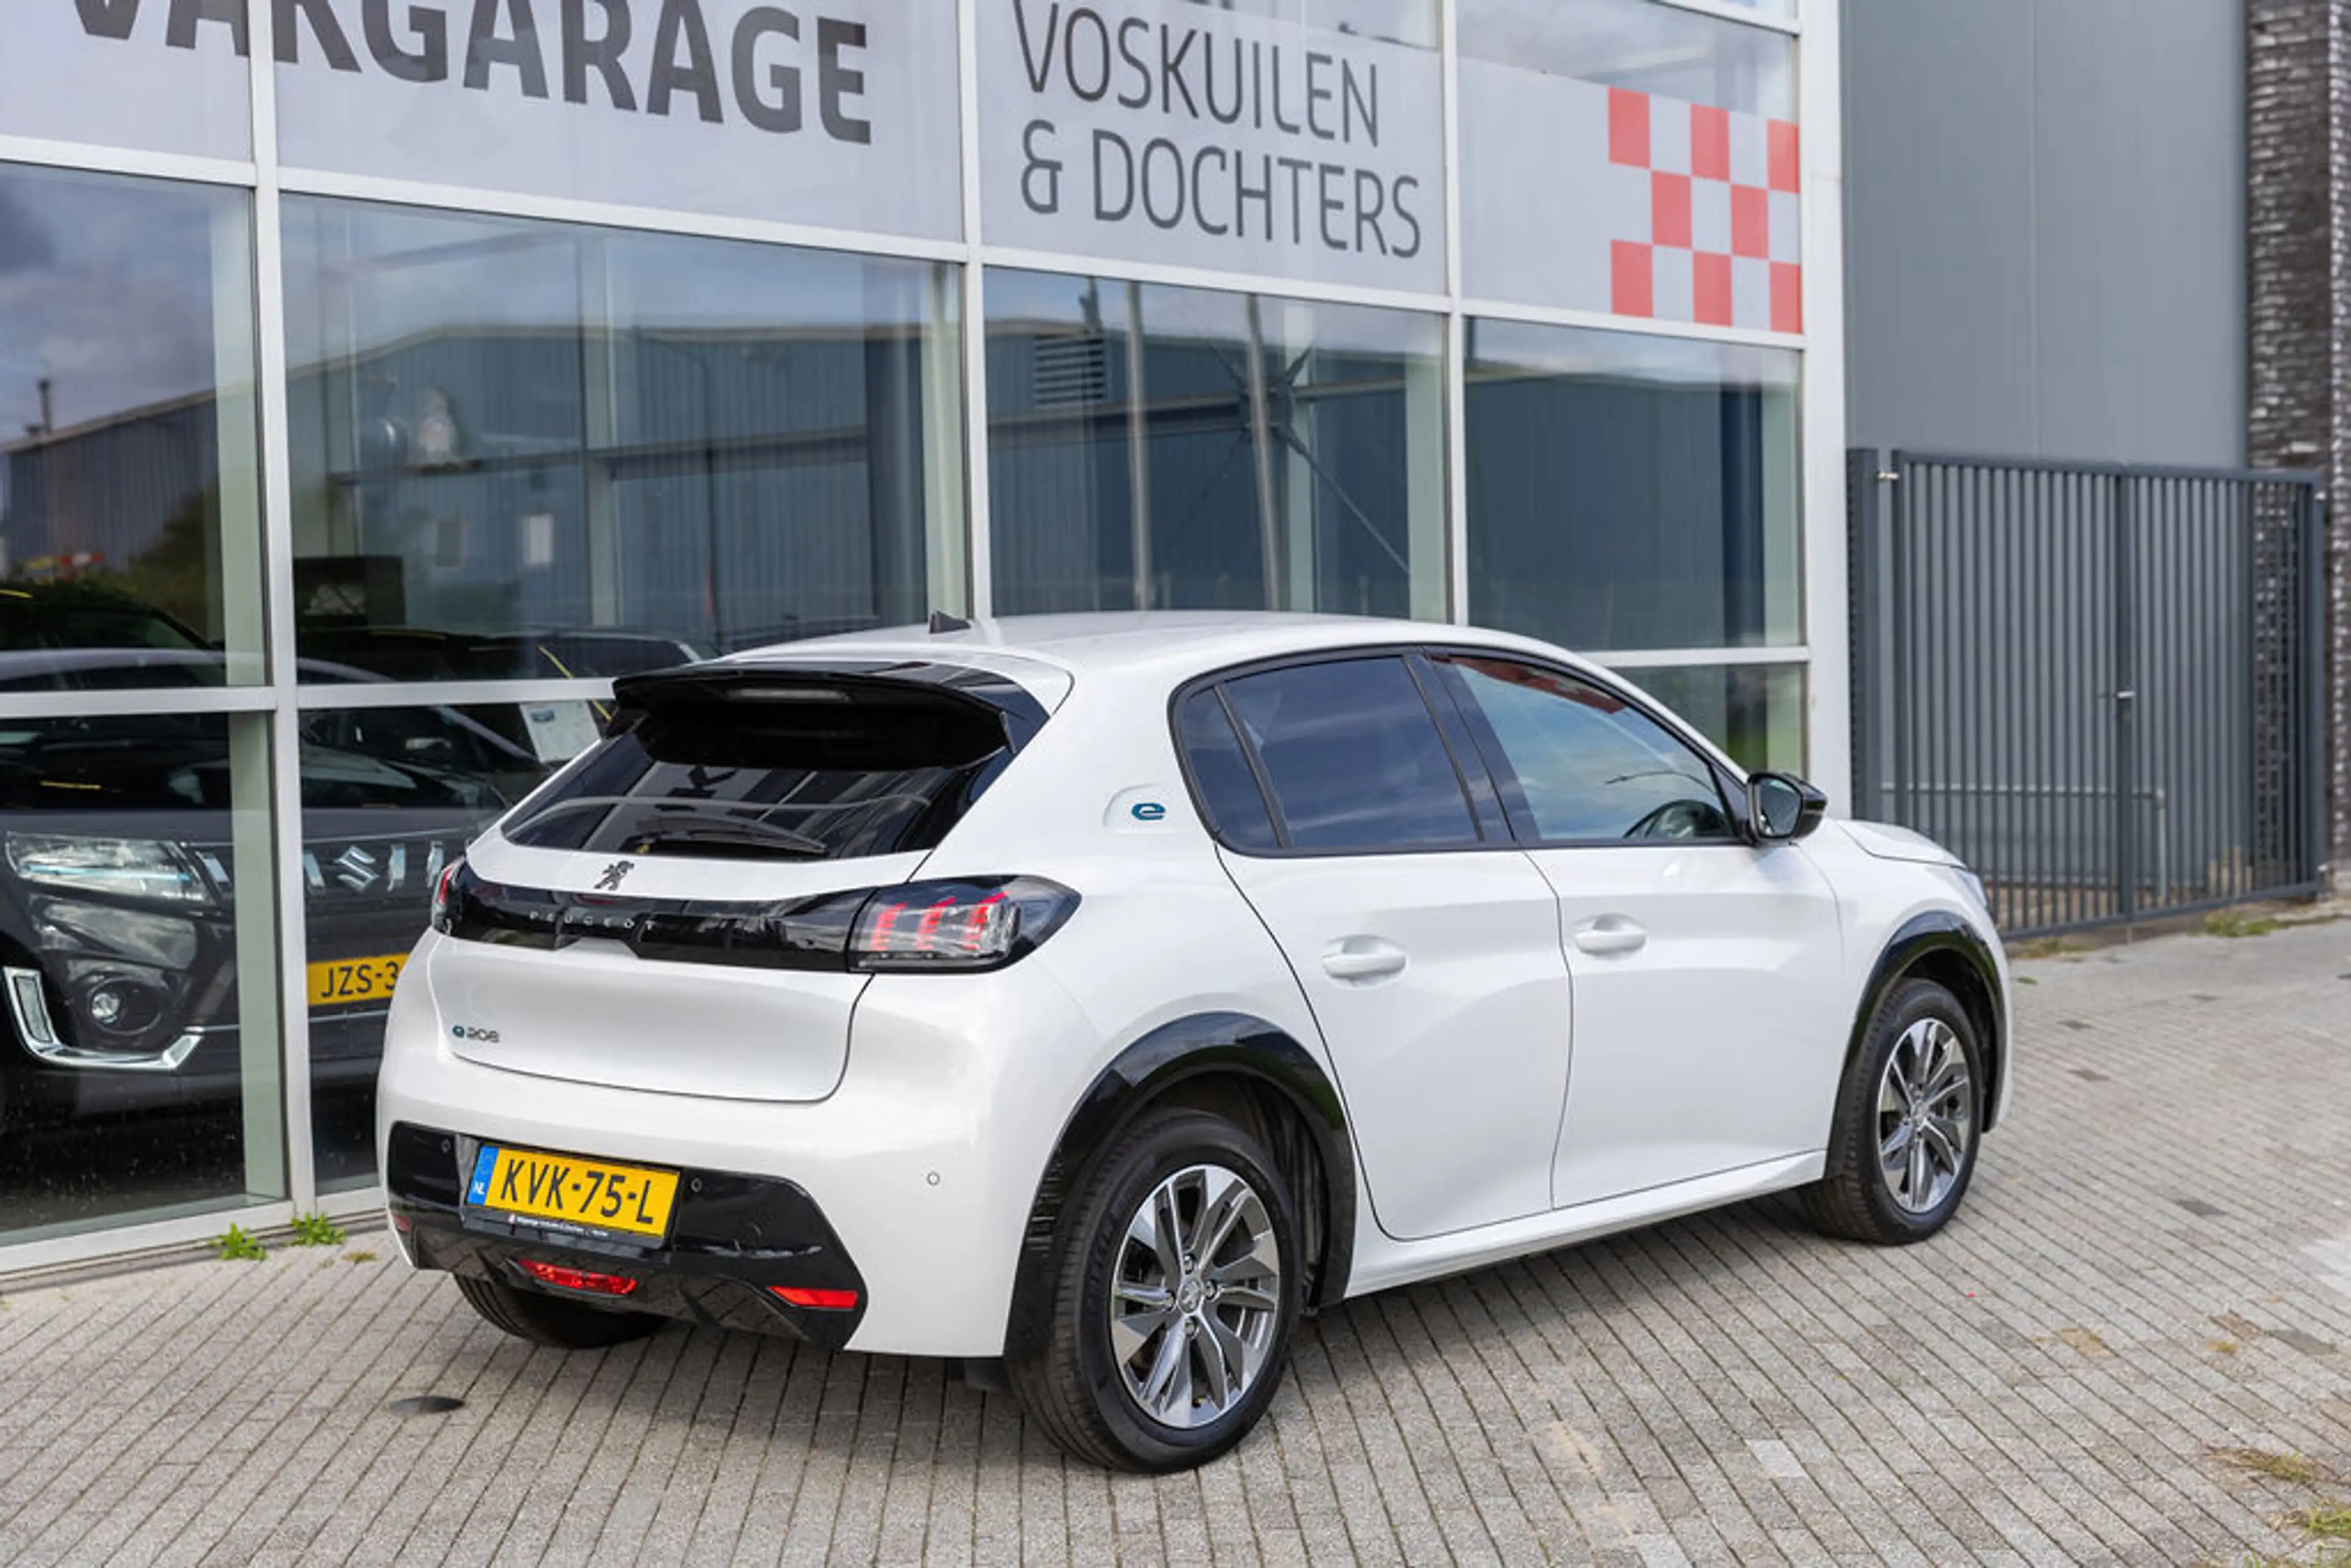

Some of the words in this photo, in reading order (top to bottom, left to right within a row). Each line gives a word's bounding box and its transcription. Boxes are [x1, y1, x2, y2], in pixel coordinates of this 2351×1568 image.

[72, 0, 871, 145] GARAGE
[1013, 0, 1378, 147] VOSKUILEN
[1021, 119, 1062, 214] &
[1092, 129, 1420, 258] DOCHTERS
[530, 910, 656, 930] PEUGEOT
[500, 1158, 653, 1225] KVK-75-L
